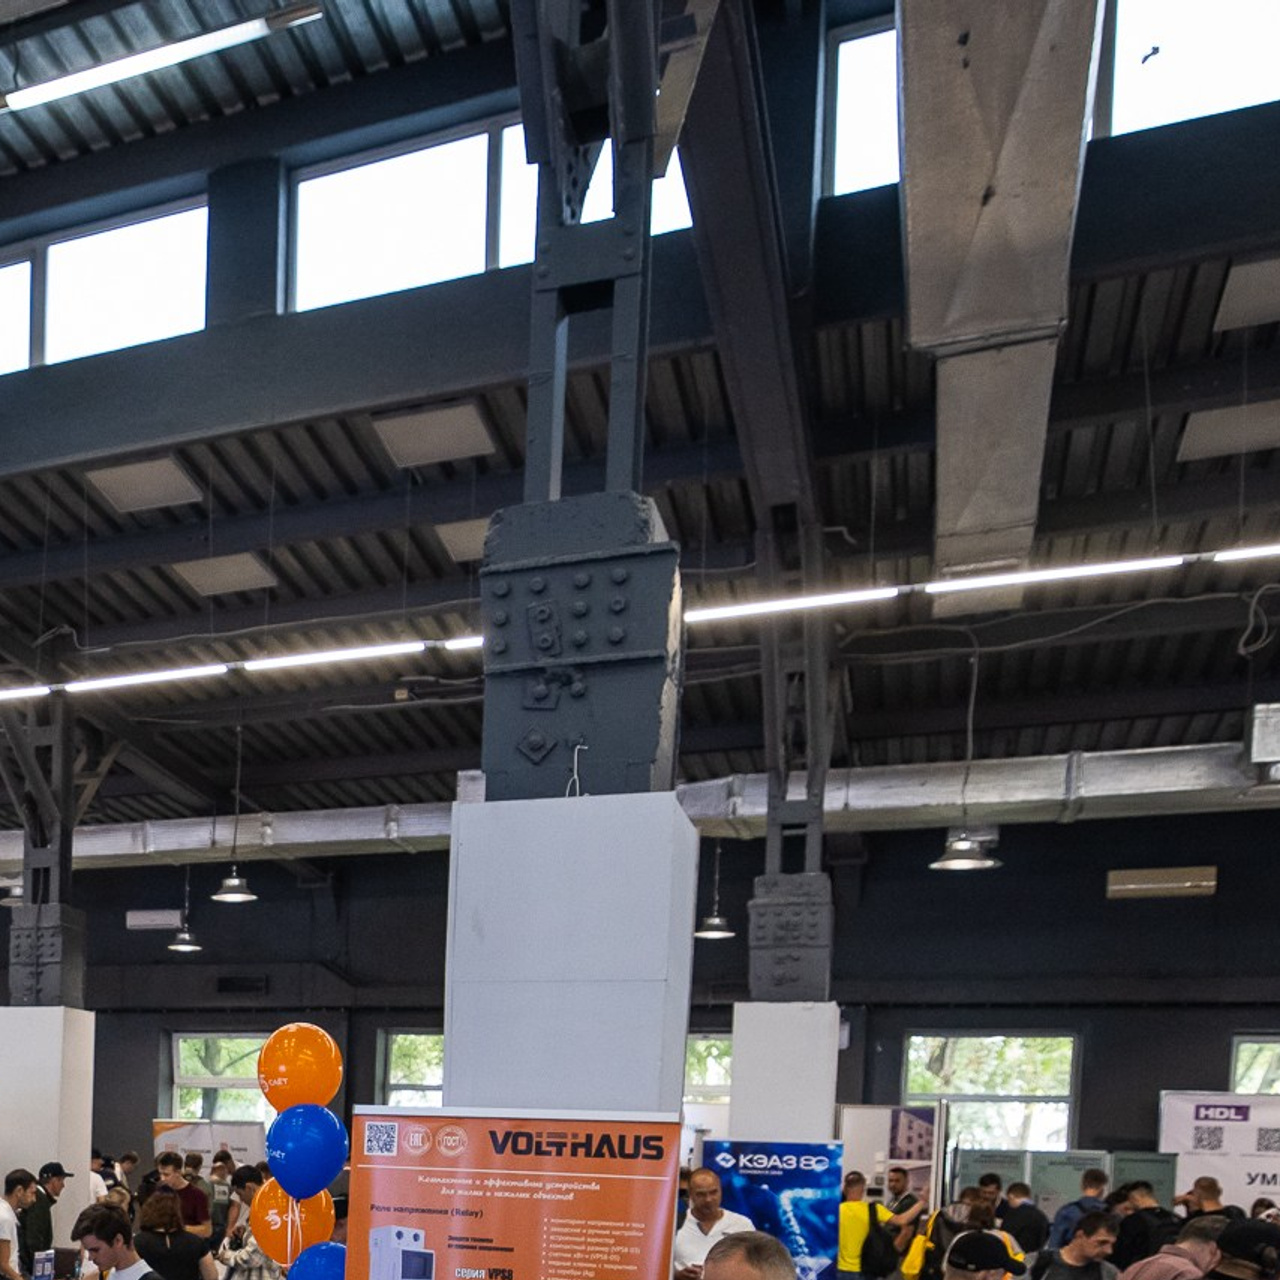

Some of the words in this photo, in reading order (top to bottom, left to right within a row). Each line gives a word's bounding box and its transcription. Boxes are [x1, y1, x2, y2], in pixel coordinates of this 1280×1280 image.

[1200, 1107, 1244, 1120] HDL
[489, 1129, 665, 1161] VOLTHAUS
[739, 1154, 797, 1169] КЭАЗ
[1246, 1172, 1280, 1186] УМ
[370, 1203, 392, 1212] Реле
[393, 1205, 449, 1216] напряжения
[451, 1207, 483, 1219] (Relay)
[455, 1266, 485, 1280] серия
[488, 1267, 514, 1280] VPS8
